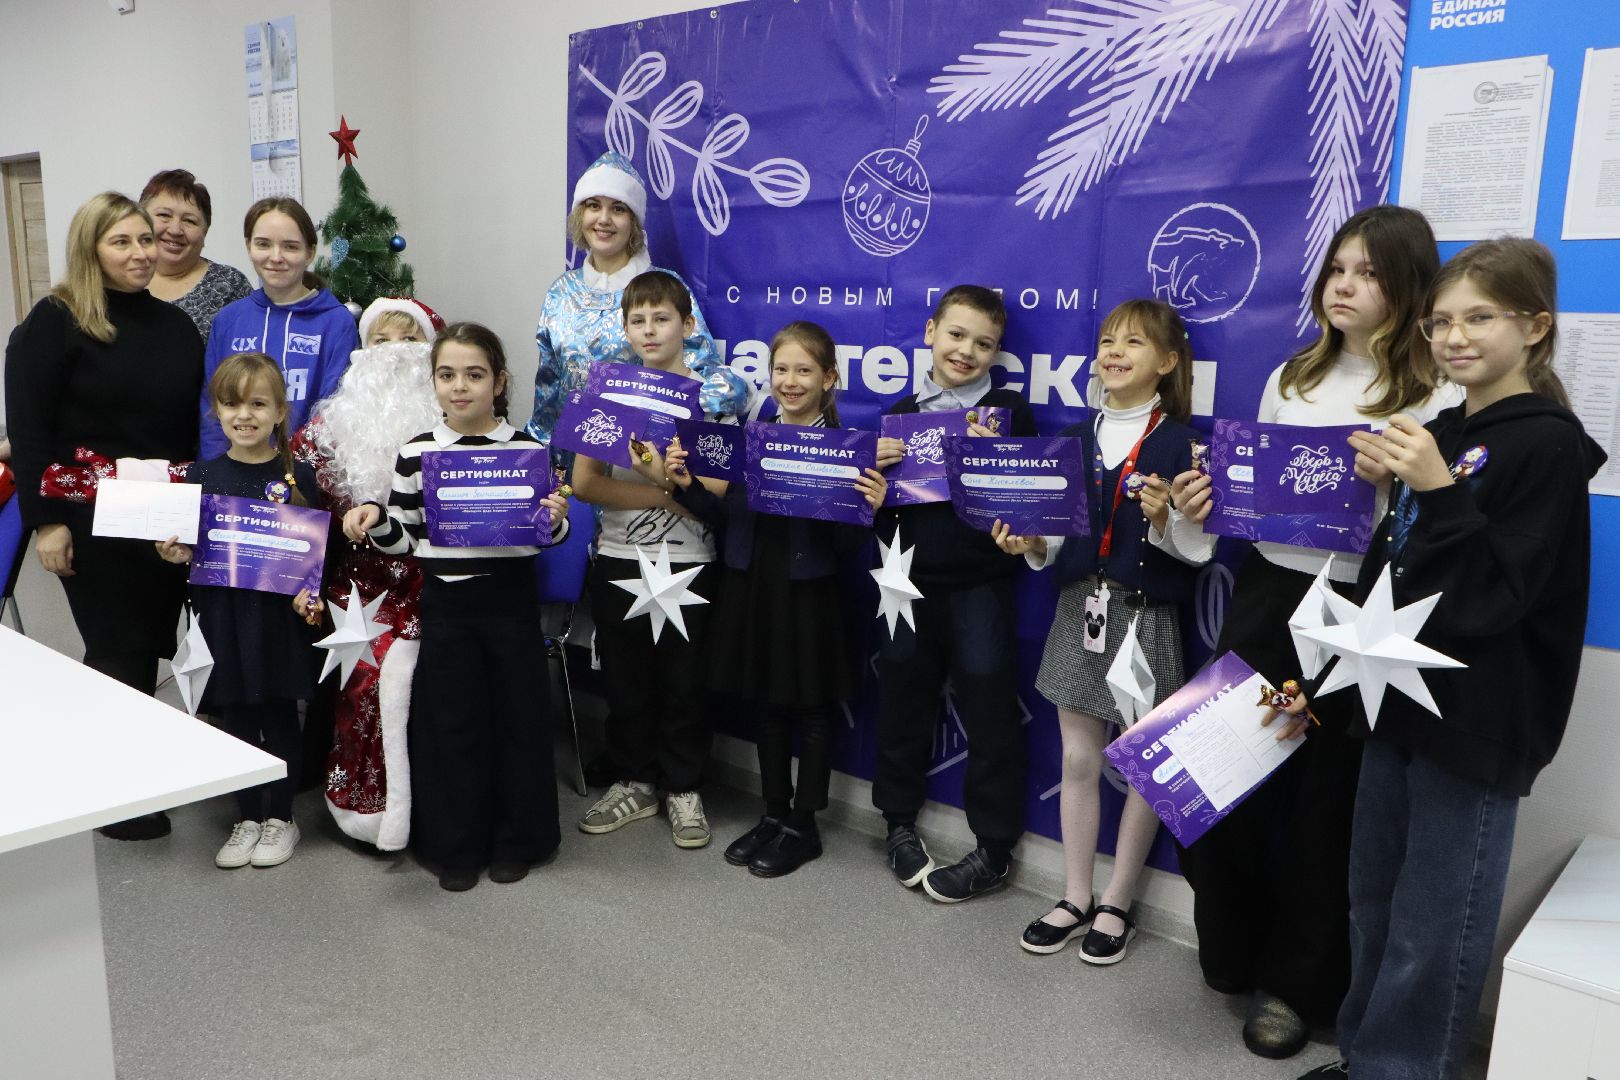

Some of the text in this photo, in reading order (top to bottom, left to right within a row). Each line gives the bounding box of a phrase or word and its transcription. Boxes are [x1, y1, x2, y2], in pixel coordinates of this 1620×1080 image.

[1430, 9, 1505, 30] РОССИЯ
[726, 286, 1097, 310] С НОВЫМ ГОМ!
[605, 379, 690, 401] СЕРТИФИКАТ
[765, 442, 856, 459] СЕРТИФИКАТ
[962, 456, 1059, 468] СЕРТИФИКАТ
[440, 469, 529, 480] СЕРТИФИКАТ
[215, 513, 309, 533] СЕРТИФИКАТ
